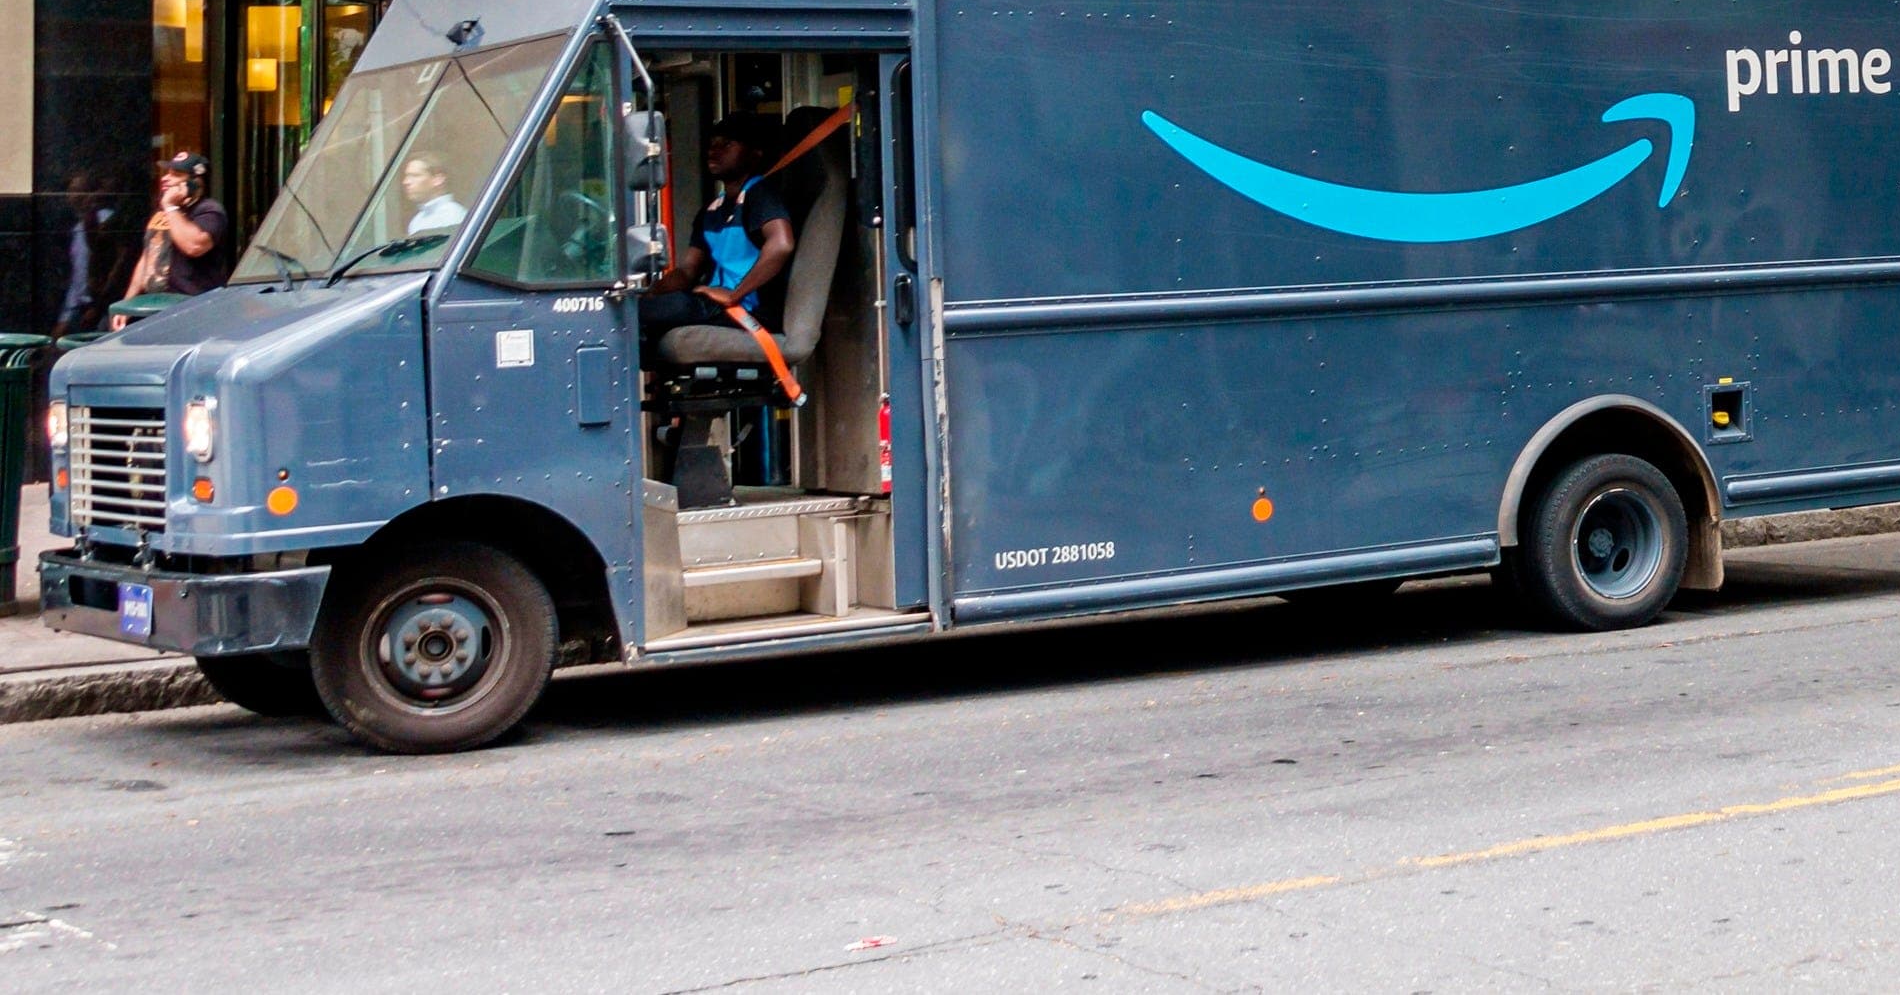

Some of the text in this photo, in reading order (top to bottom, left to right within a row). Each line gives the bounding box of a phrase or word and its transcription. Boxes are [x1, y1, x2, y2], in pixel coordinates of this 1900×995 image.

[1726, 30, 1892, 112] prime
[552, 296, 605, 313] 400716
[995, 541, 1116, 570] USDOT 2881058
